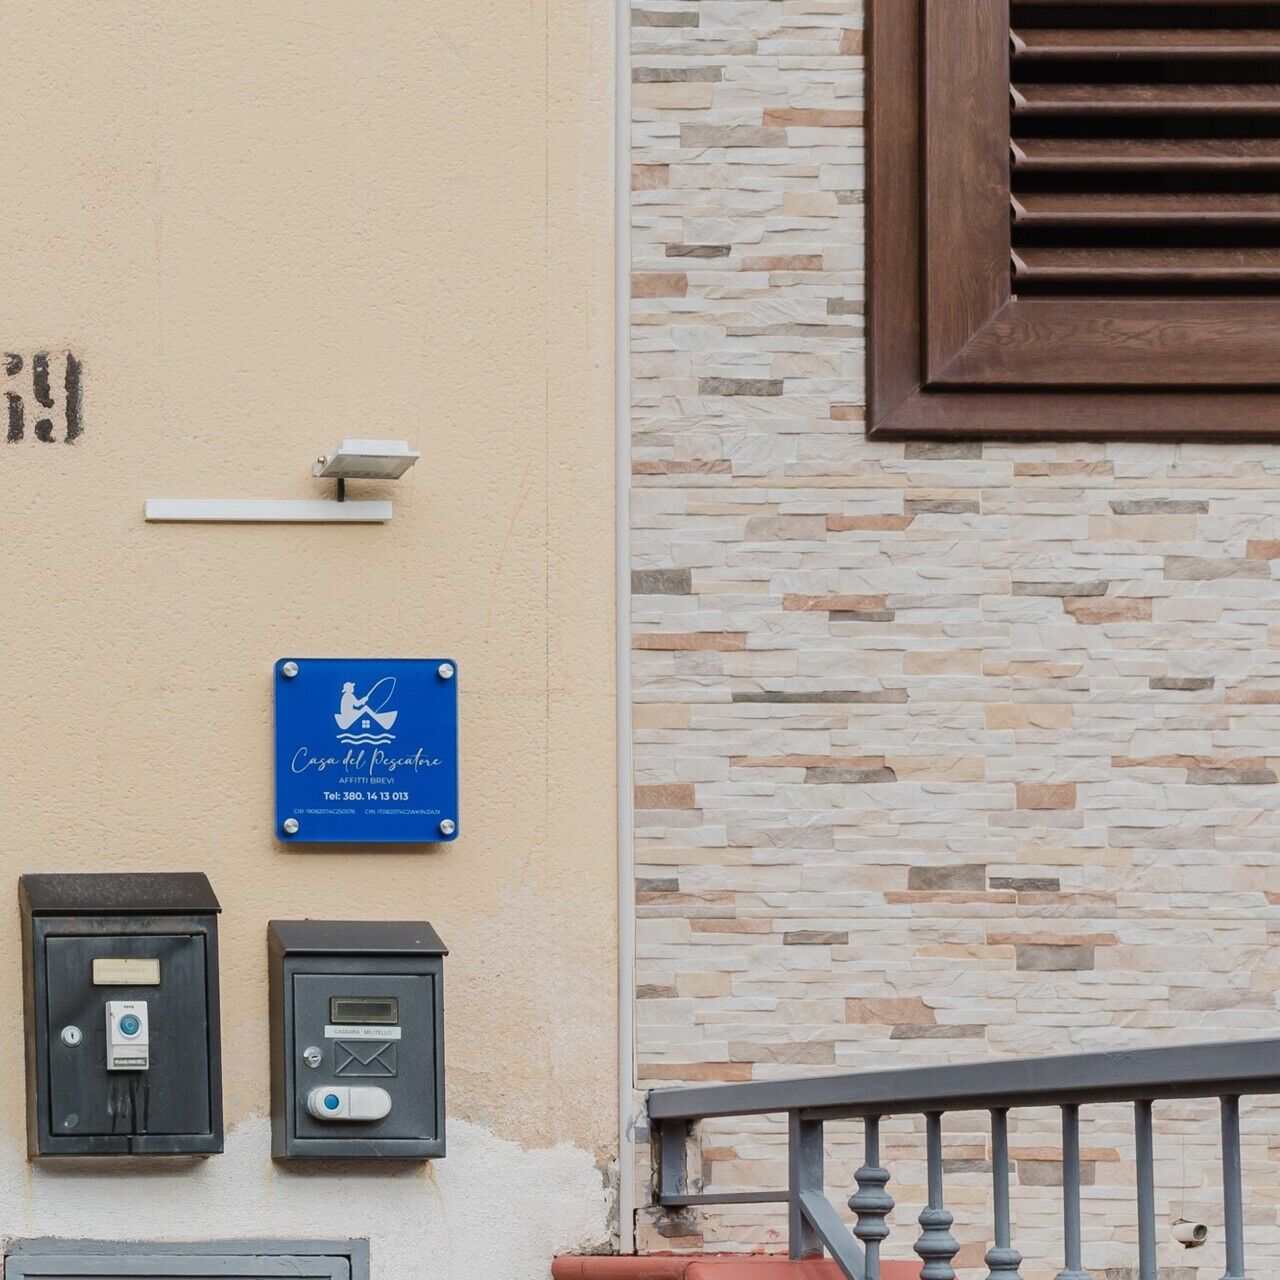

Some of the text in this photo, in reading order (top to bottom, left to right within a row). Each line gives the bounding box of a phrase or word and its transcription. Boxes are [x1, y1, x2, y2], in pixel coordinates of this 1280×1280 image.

[291, 747, 443, 776] Casa del Pescatore
[338, 777, 395, 785] AFFITTI BREVI
[323, 791, 409, 801] Tel: 380. 14 13 013
